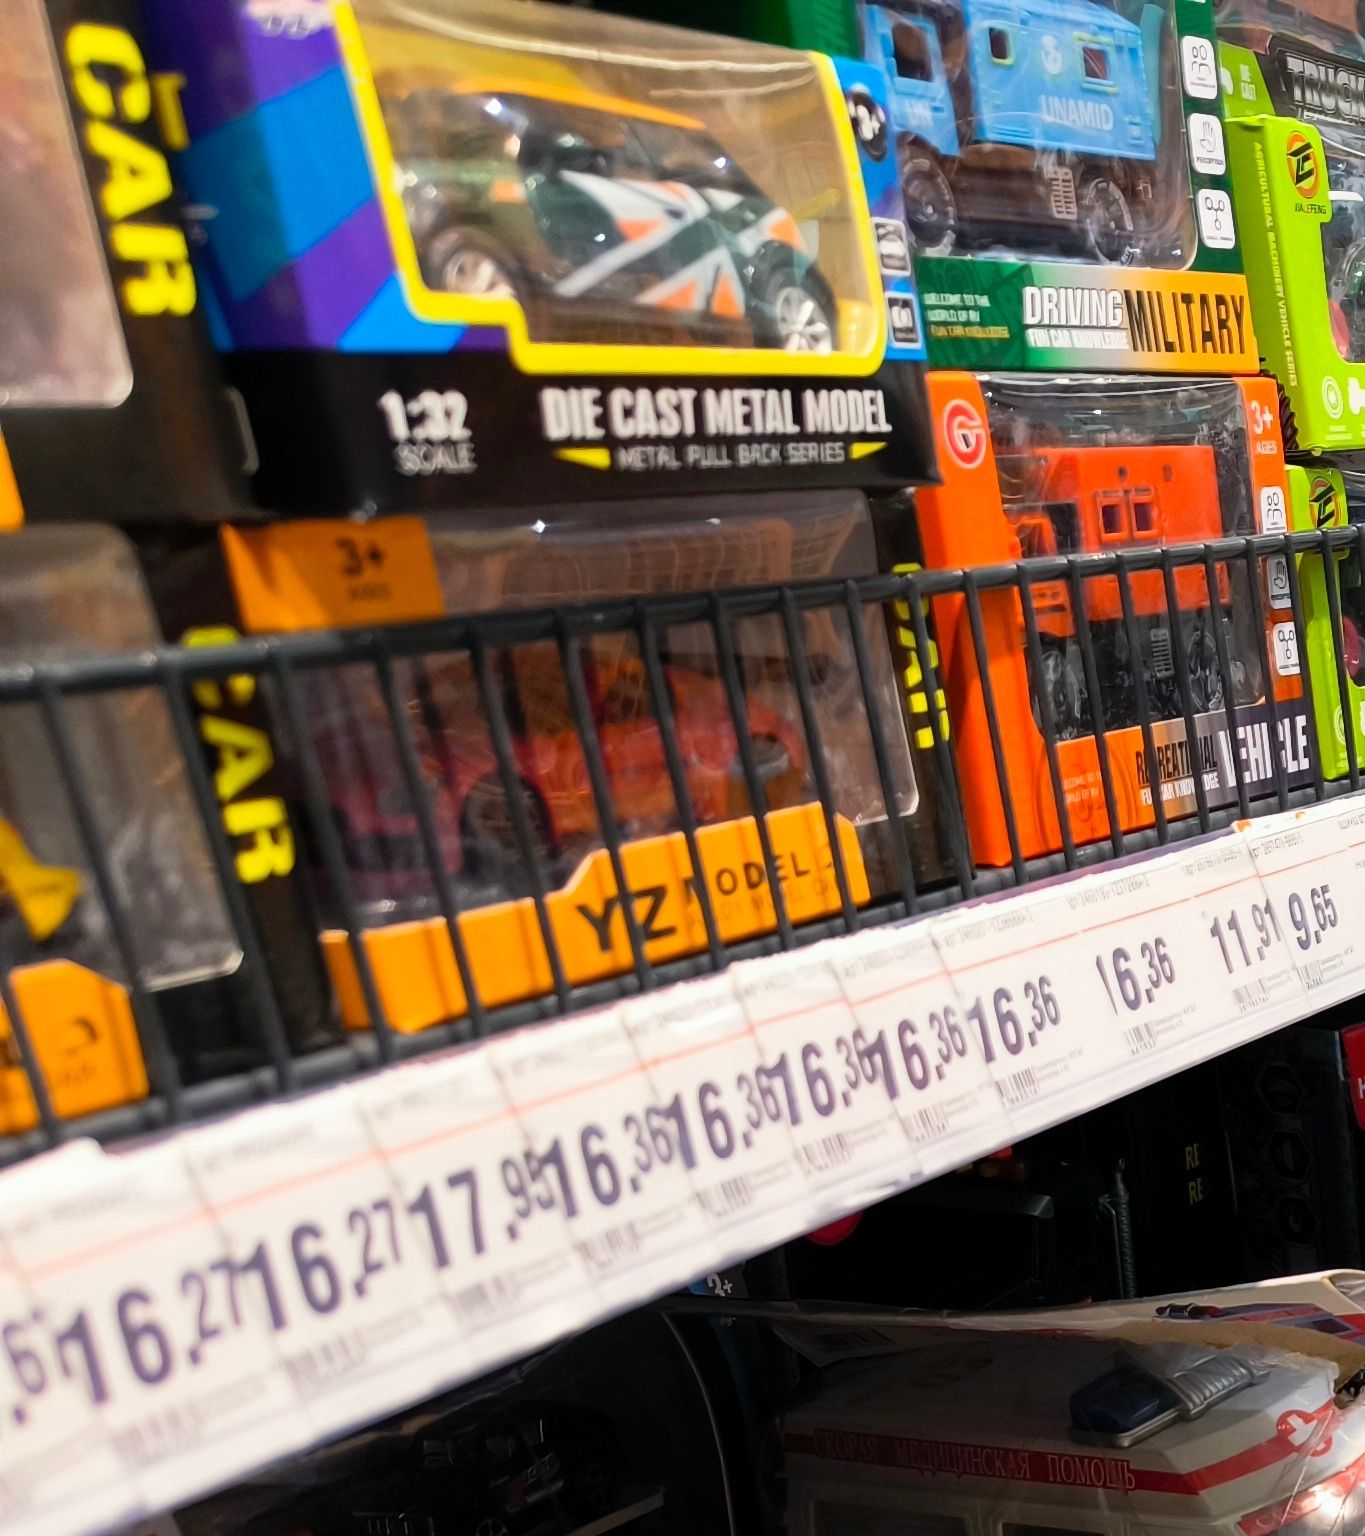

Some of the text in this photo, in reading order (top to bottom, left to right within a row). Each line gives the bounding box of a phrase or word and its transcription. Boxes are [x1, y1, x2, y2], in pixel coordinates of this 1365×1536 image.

[1041, 95, 1114, 131] UNAMID
[63, 22, 197, 318] CAR
[1023, 286, 1246, 355] DRIVING MILITARY
[380, 388, 472, 441] 1:32
[539, 387, 893, 442] DIE CAST METAL MODEL
[1251, 399, 1275, 435] 3+
[786, 440, 846, 464] SERIES
[336, 536, 385, 577] 3+
[575, 885, 679, 954] YZ
[1210, 895, 1283, 974] 11,91
[1288, 884, 1339, 951] 9,65
[1095, 935, 1177, 1017] 16,36
[862, 1002, 969, 1100] 16,36
[965, 974, 1062, 1064] 16,36
[757, 1028, 879, 1128] 16,36
[647, 1063, 784, 1171] 16,36
[527, 1105, 676, 1220] 16,36
[231, 1198, 403, 1333] 16,27
[57, 1258, 244, 1408] 16,27
[813, 1429, 1137, 1495] СКОРАЯ МЕДИЦИНСКАЯ ПОМОЩЬ
